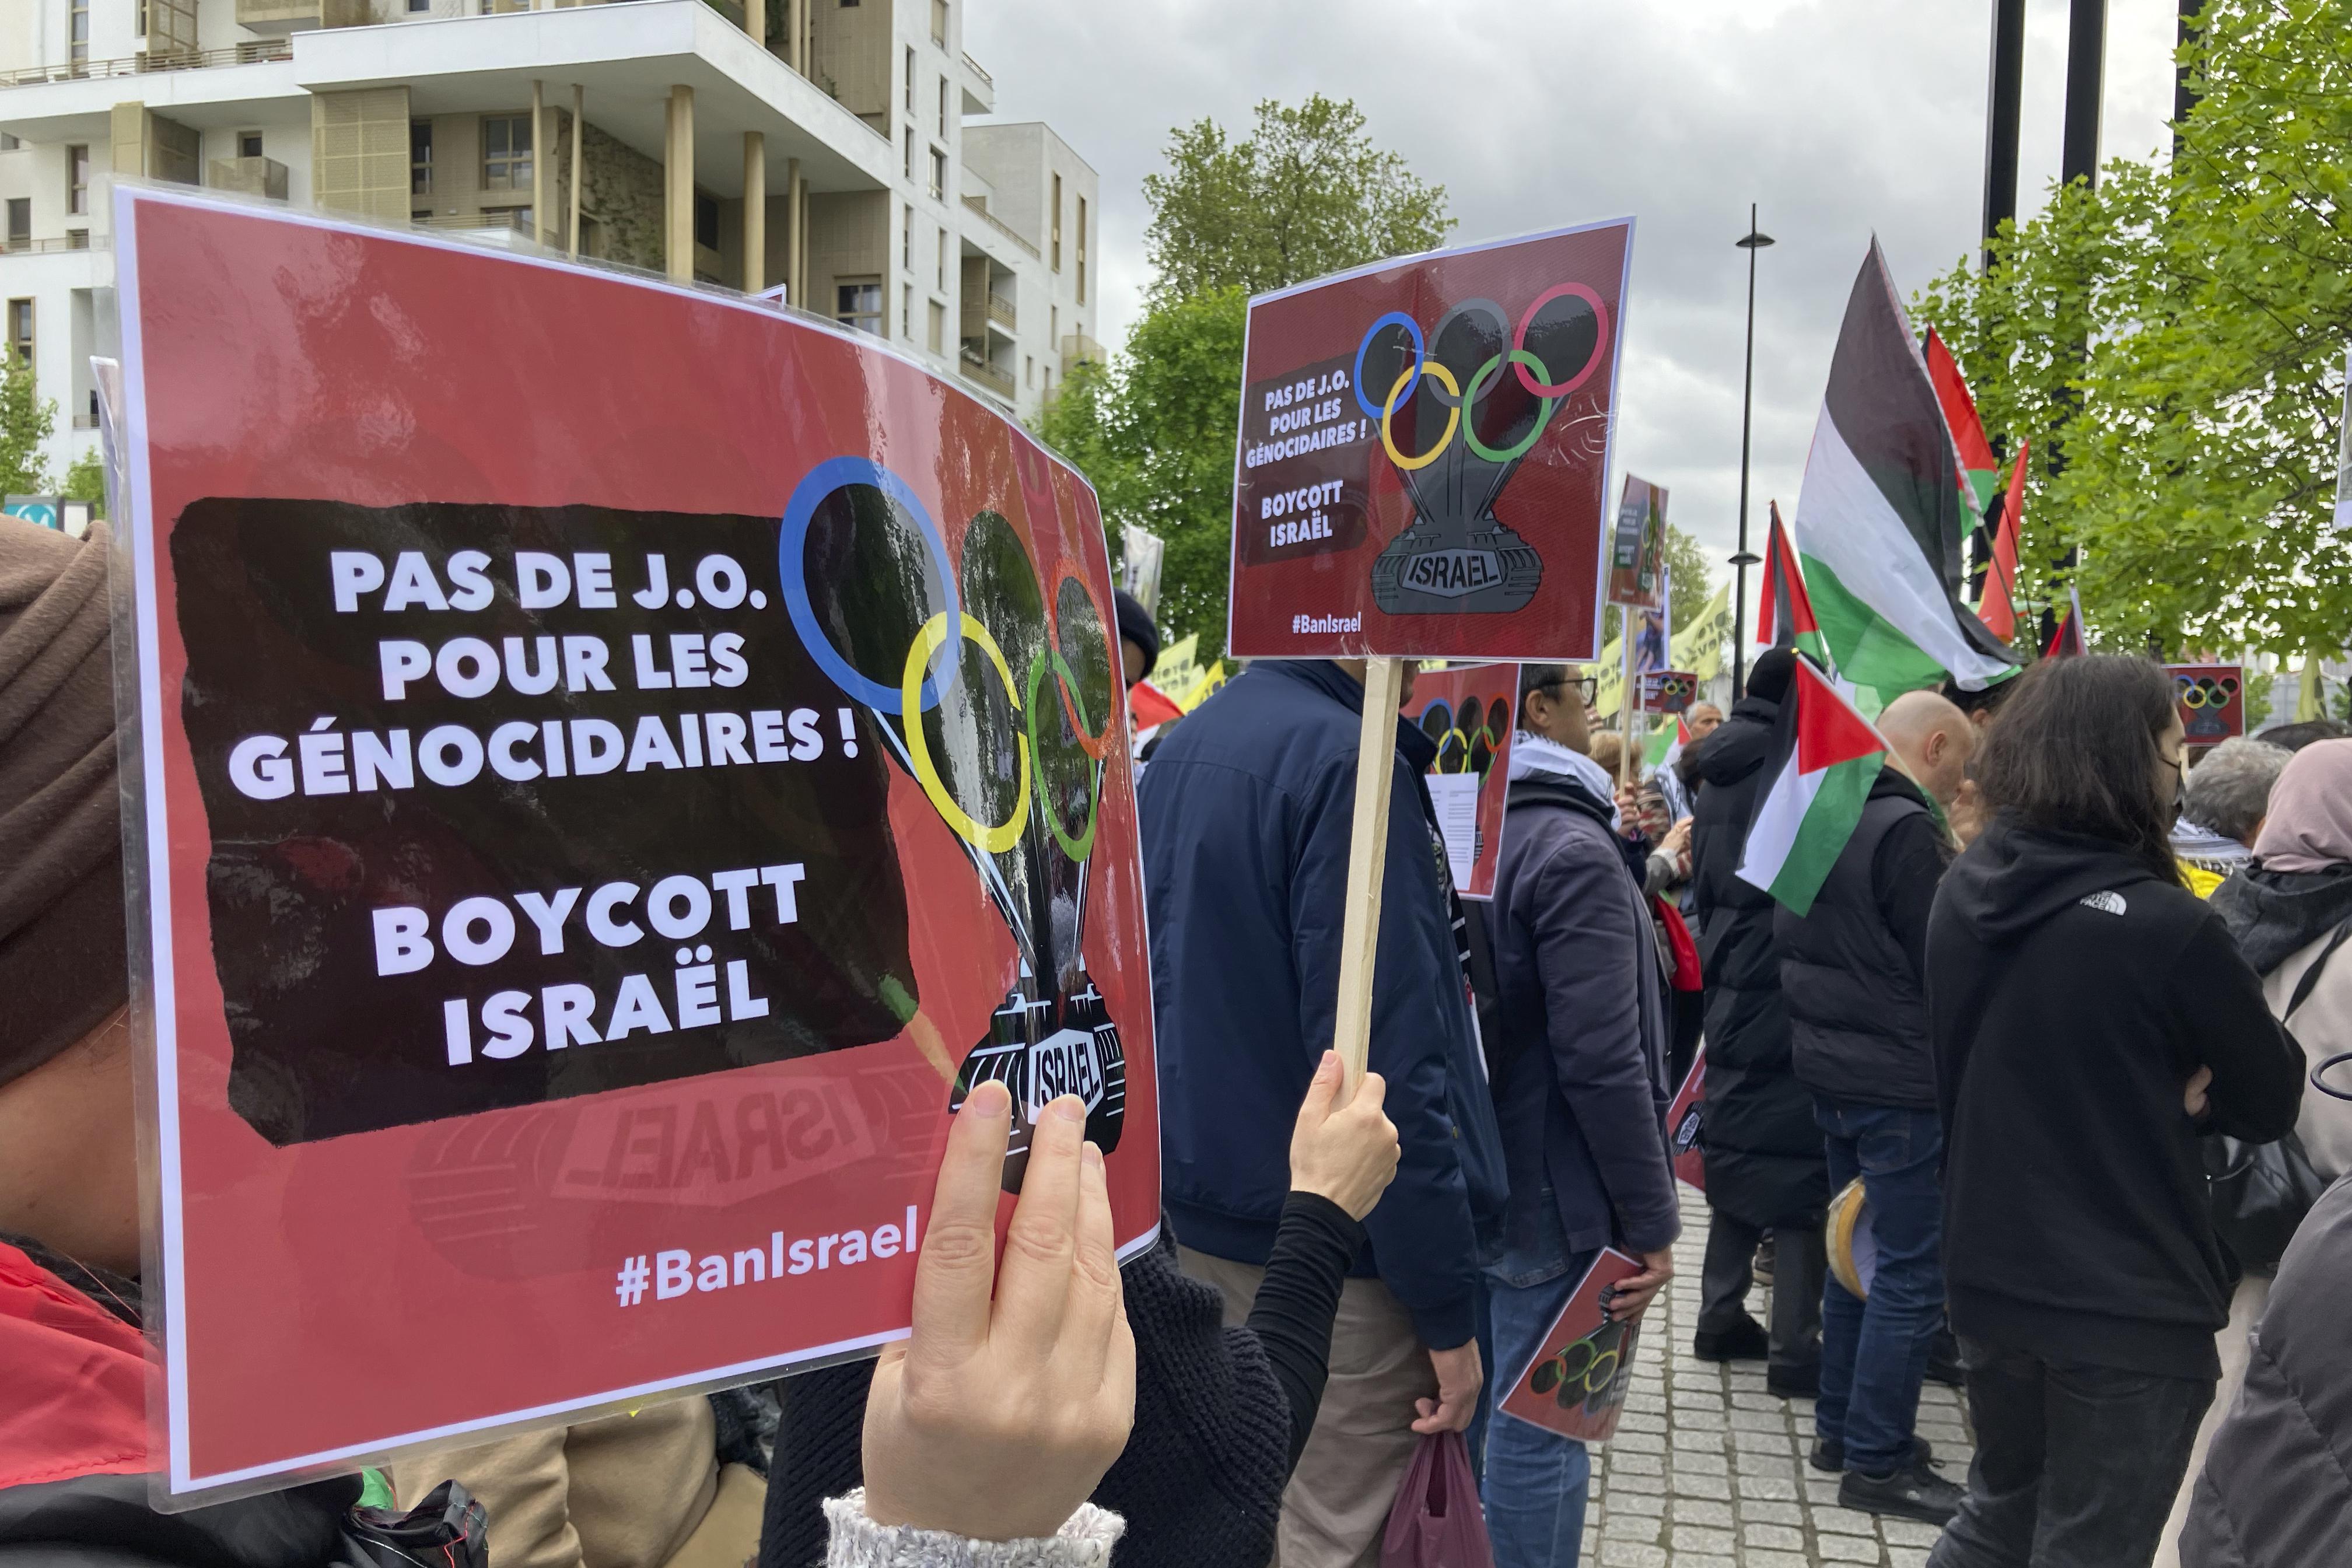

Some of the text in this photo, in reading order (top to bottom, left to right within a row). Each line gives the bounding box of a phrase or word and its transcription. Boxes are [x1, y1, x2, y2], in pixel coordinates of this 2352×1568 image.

[1265, 369, 1350, 412] PAS DE J.O.
[1269, 397, 1342, 436] POUR LES
[1246, 418, 1367, 469] GÉNOCIDAIRES !
[1262, 480, 1343, 520] BOYCOTT
[1270, 509, 1333, 547] ISRAËL
[331, 550, 768, 612] PAS DE J.O.
[1408, 555, 1500, 590] ISRAEL
[1292, 610, 1362, 634] #BanIsrael
[379, 632, 749, 701] POUR LES
[229, 708, 859, 800] GÉNOCIDAIRES !
[372, 863, 805, 977] BOYCOTT
[444, 944, 770, 1066] ISRAËL
[1034, 1042, 1101, 1108] ISRAEL
[615, 1205, 918, 1307] #BanIsrael
